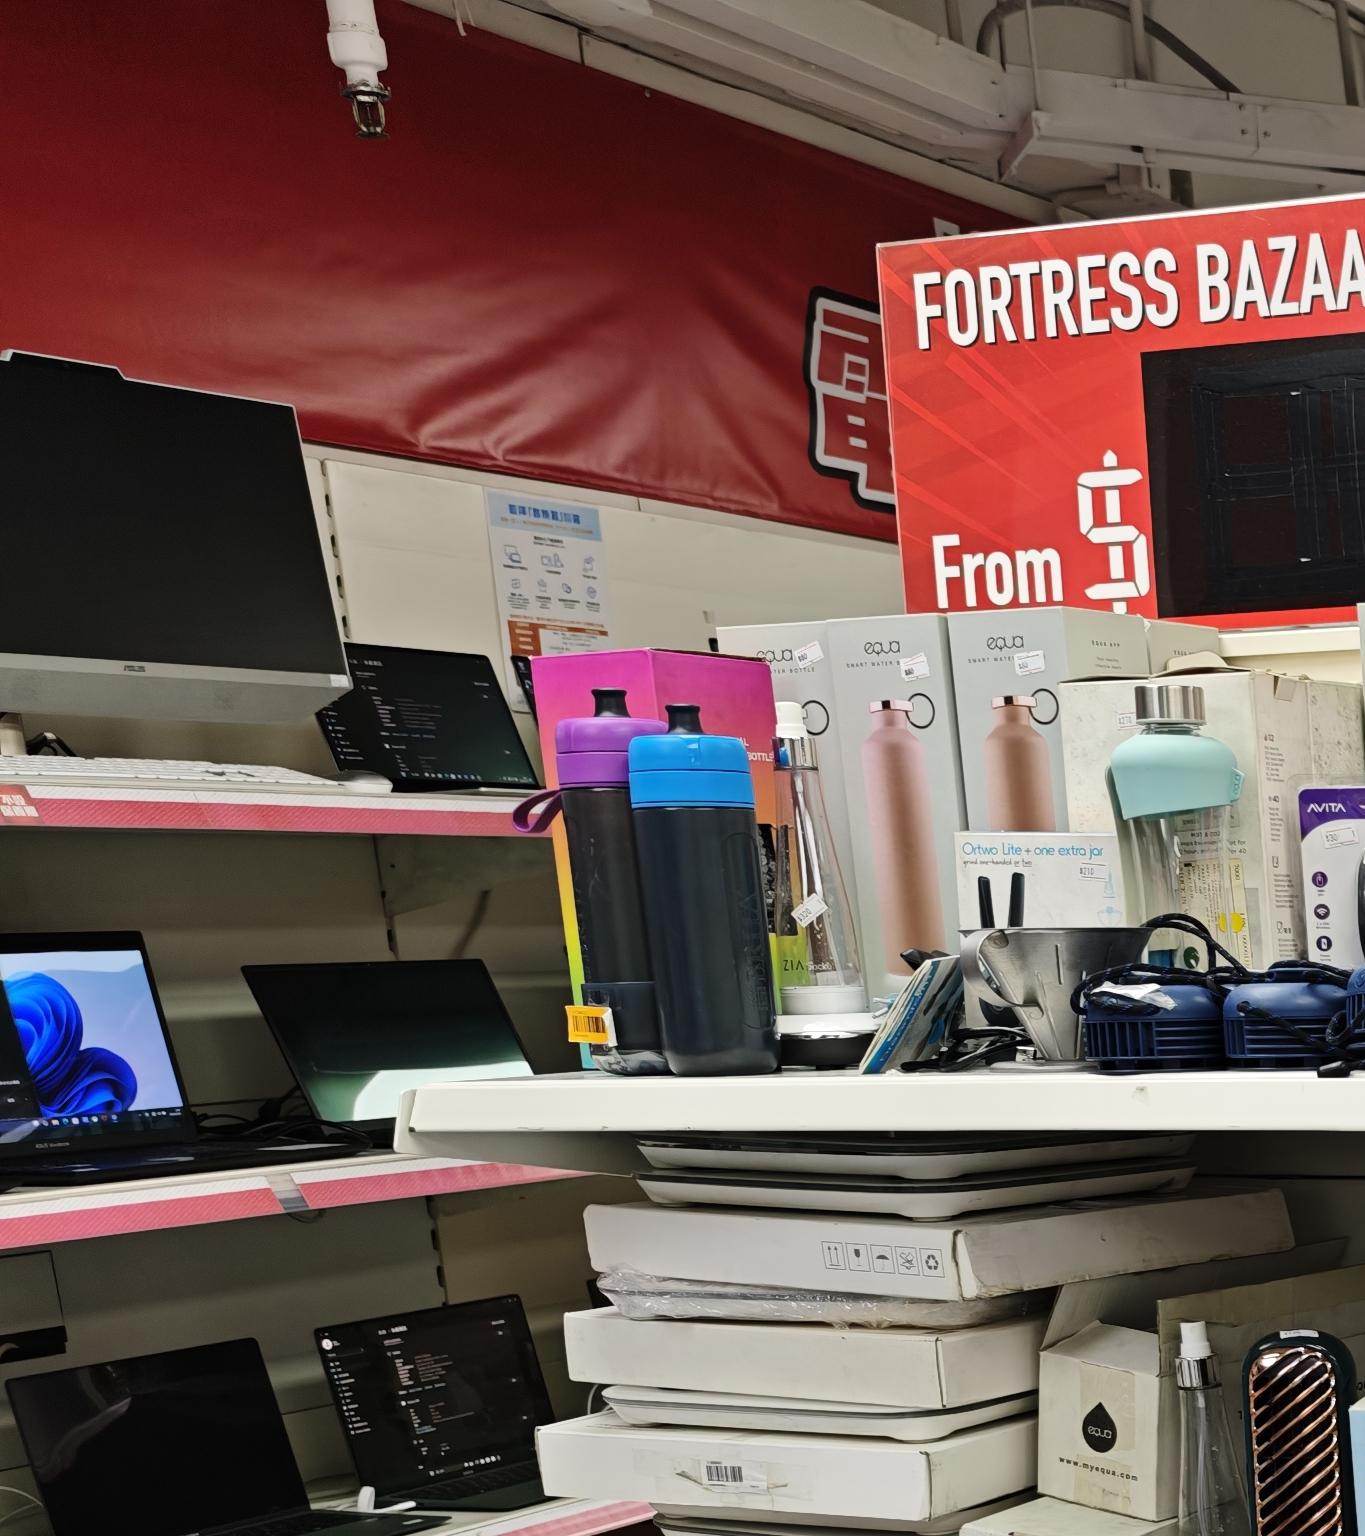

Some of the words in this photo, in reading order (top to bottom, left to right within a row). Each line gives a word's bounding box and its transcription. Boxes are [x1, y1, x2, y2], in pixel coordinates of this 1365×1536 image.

[913, 247, 1179, 351] FORTRESS
[931, 532, 1065, 610] From
[864, 640, 900, 657] equa
[986, 635, 1024, 651] equa
[1306, 801, 1346, 814] AVITA
[1058, 1456, 1139, 1482] www.myequa.com
